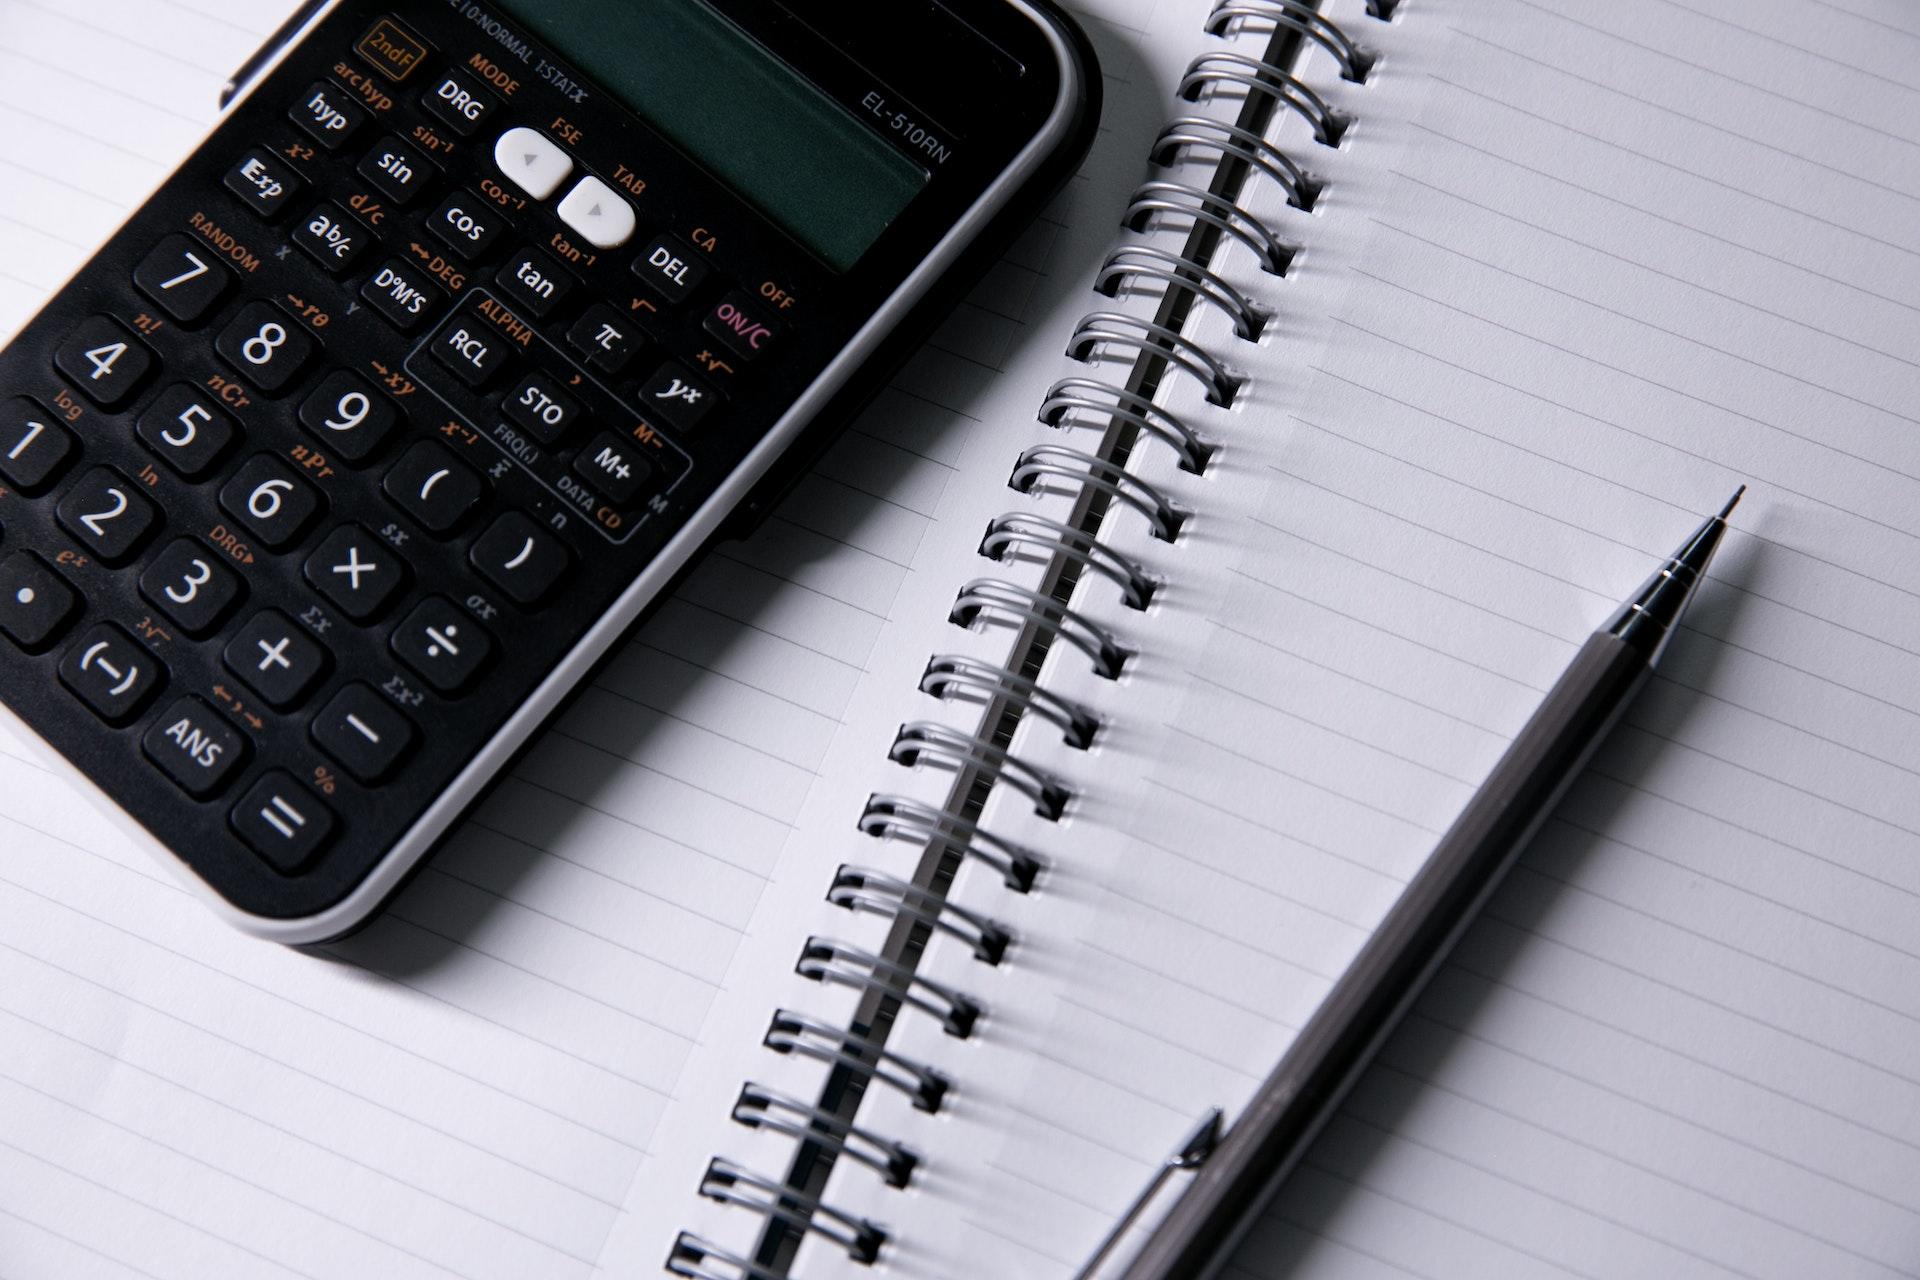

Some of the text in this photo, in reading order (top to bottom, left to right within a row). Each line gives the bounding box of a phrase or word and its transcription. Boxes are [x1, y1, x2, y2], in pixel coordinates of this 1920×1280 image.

[369, 33, 414, 67] 2ndF
[469, 53, 520, 95] MODE
[308, 92, 347, 129] hyp
[437, 79, 484, 121] DRG
[551, 116, 584, 146] FSE
[861, 91, 952, 164] EL-510RN
[240, 158, 282, 199] Exp
[377, 152, 413, 184] sin
[612, 164, 646, 196] TAB
[350, 193, 385, 225] d/c
[446, 207, 485, 241] cos
[189, 212, 261, 273] RANDOM
[691, 227, 717, 252] CA
[161, 251, 209, 290] 7
[427, 256, 466, 290] DEG
[516, 261, 555, 298] tan
[648, 246, 689, 287] DEL
[760, 281, 796, 311] OFF
[133, 312, 163, 335] n!
[478, 298, 532, 346] ALPHA
[716, 303, 771, 349] ON/C
[85, 342, 128, 380] 4
[243, 322, 287, 365] 8
[448, 328, 488, 368] RCL
[54, 389, 84, 421] log
[324, 391, 372, 431] 9
[520, 386, 563, 425] STO
[8, 421, 45, 460] 1
[161, 403, 213, 447] 5
[594, 447, 631, 480] M+
[80, 488, 128, 536] 2
[249, 479, 294, 519] 6
[556, 475, 622, 529] DATA CD
[649, 494, 669, 514] M
[551, 512, 567, 530] n
[165, 559, 211, 604] 3
[165, 718, 223, 767] ANS
[315, 766, 335, 795] %
